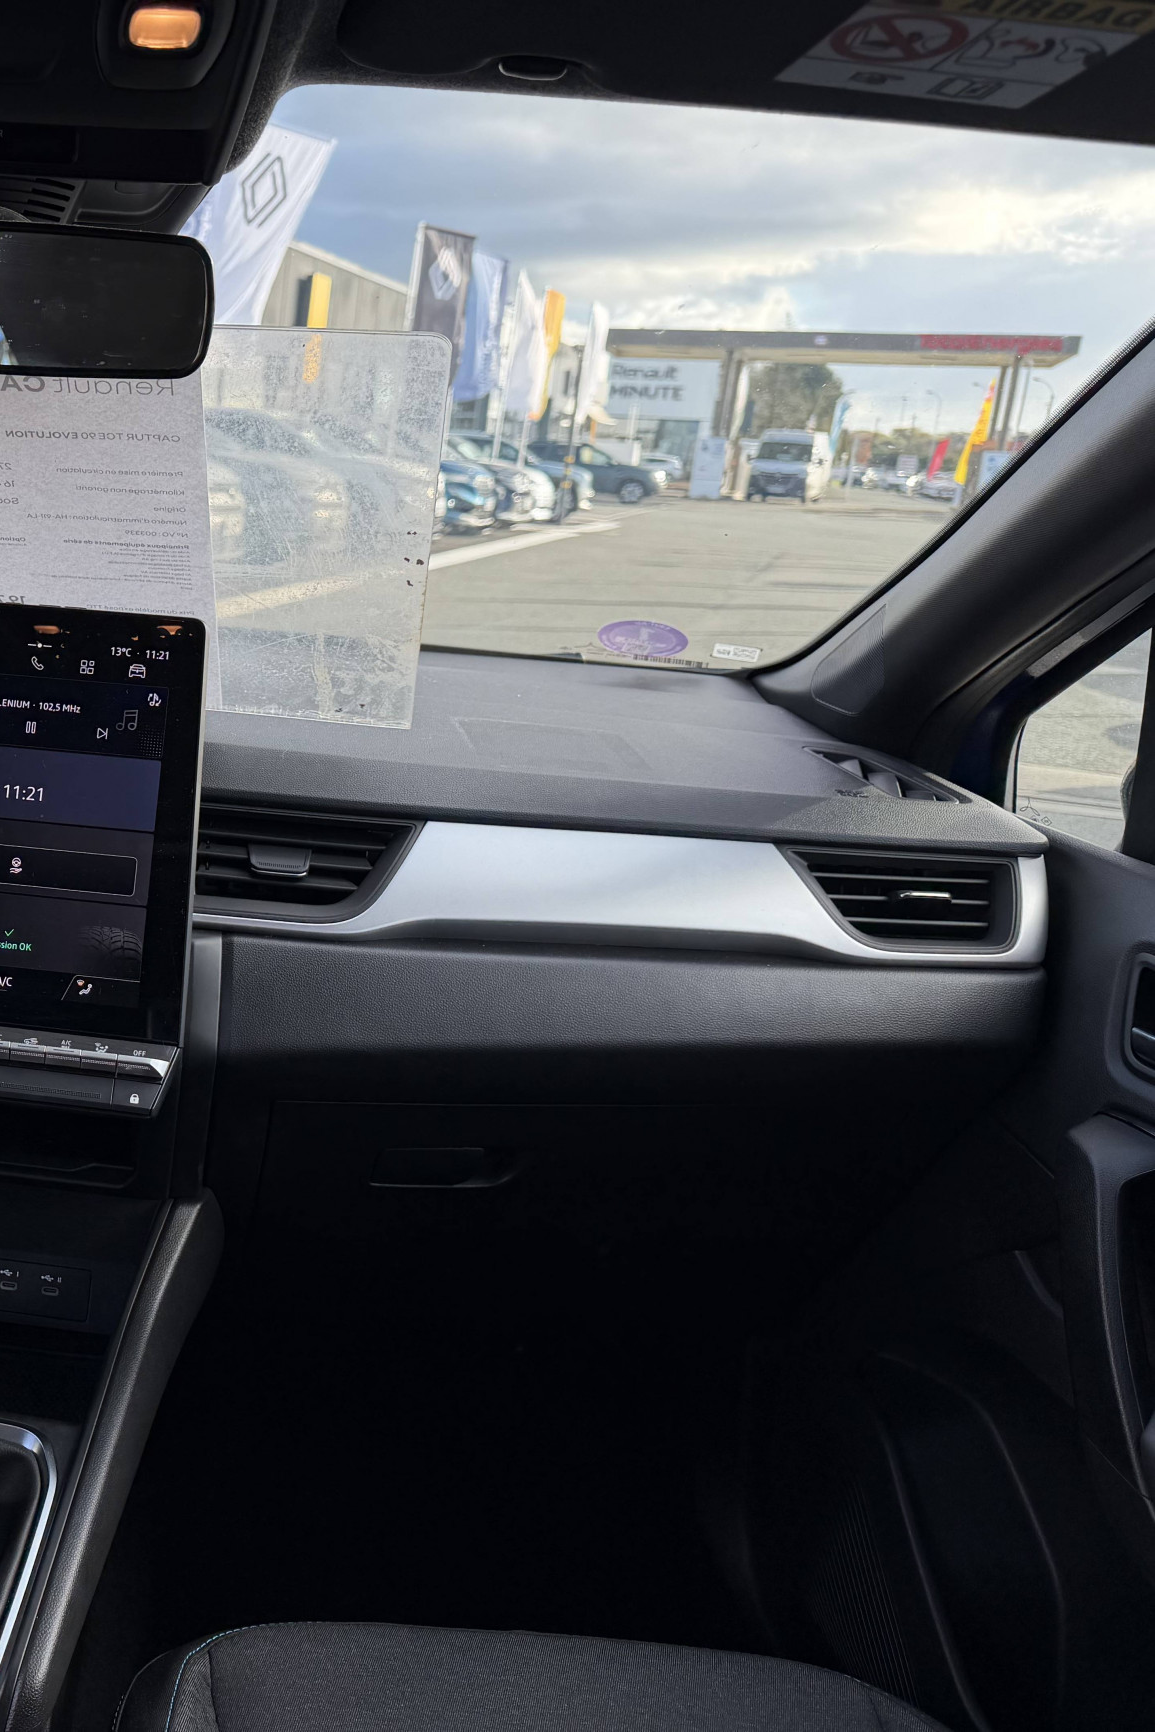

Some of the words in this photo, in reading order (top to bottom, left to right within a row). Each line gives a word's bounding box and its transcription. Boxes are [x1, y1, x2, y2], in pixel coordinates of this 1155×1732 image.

[609, 385, 684, 402] MINUTE
[145, 649, 171, 661] 11:21
[38, 701, 61, 714] 102,5
[62, 703, 81, 715] MHz
[3, 784, 45, 803] 11:21
[18, 942, 33, 952] OK
[133, 1049, 146, 1057] OFF
